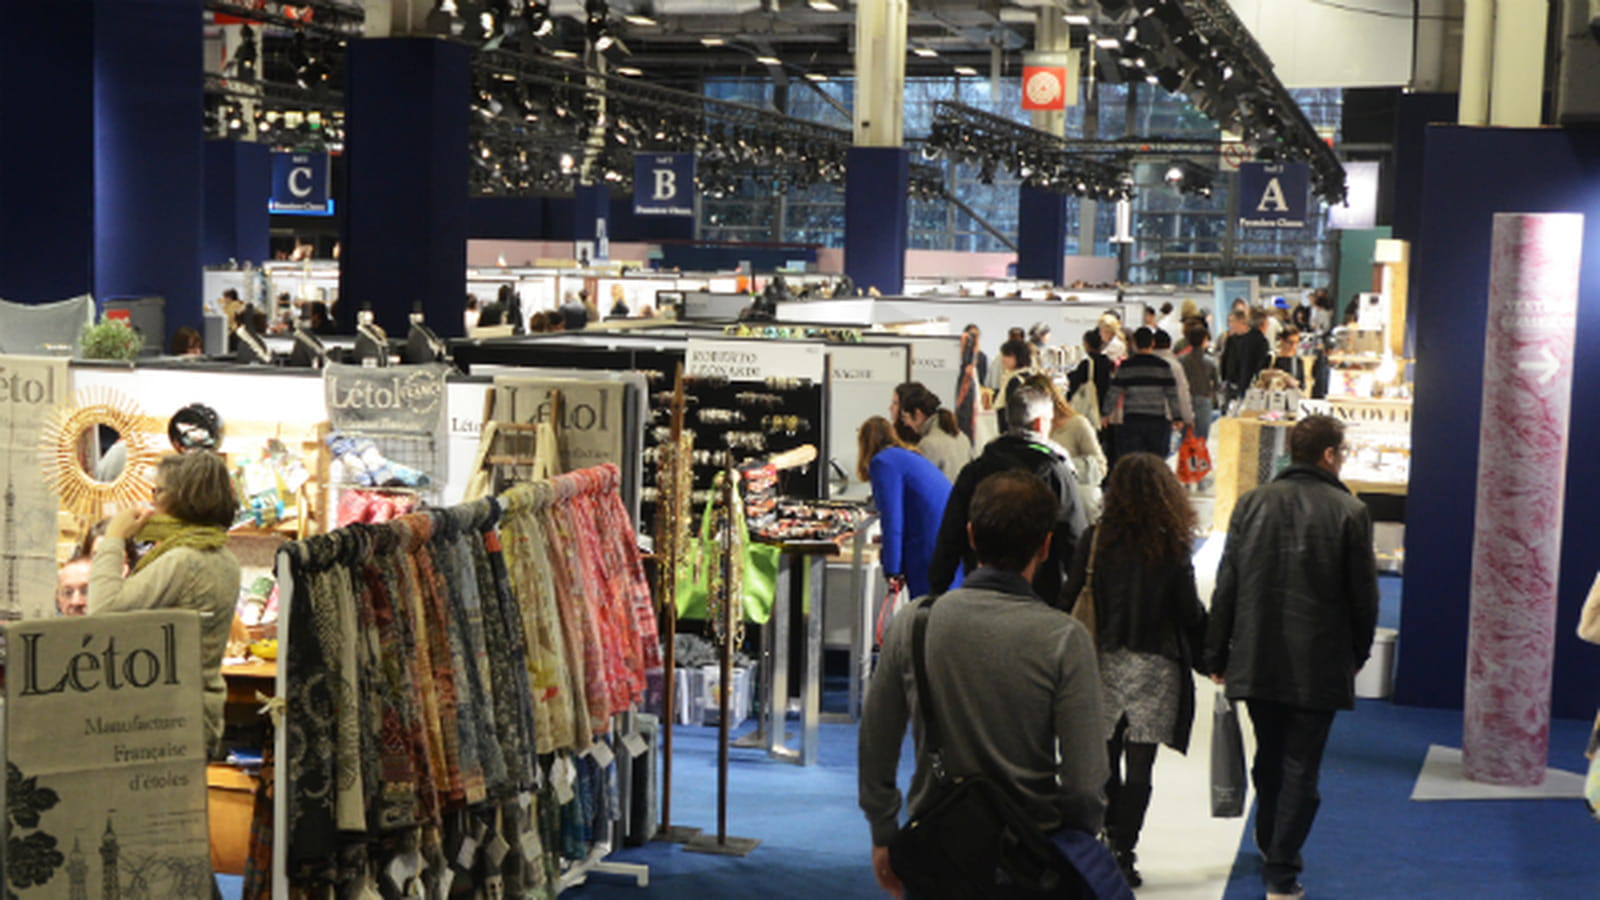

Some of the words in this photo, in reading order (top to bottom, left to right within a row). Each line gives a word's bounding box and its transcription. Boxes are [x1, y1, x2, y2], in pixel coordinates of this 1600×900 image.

[287, 166, 313, 198] C
[651, 168, 677, 201] B
[1256, 177, 1289, 212] A
[0, 366, 55, 405] étol
[329, 376, 401, 409] Létol
[451, 417, 482, 433] Léto
[19, 623, 181, 697] Létol
[83, 714, 187, 736] Manufacture
[113, 742, 188, 763] Française
